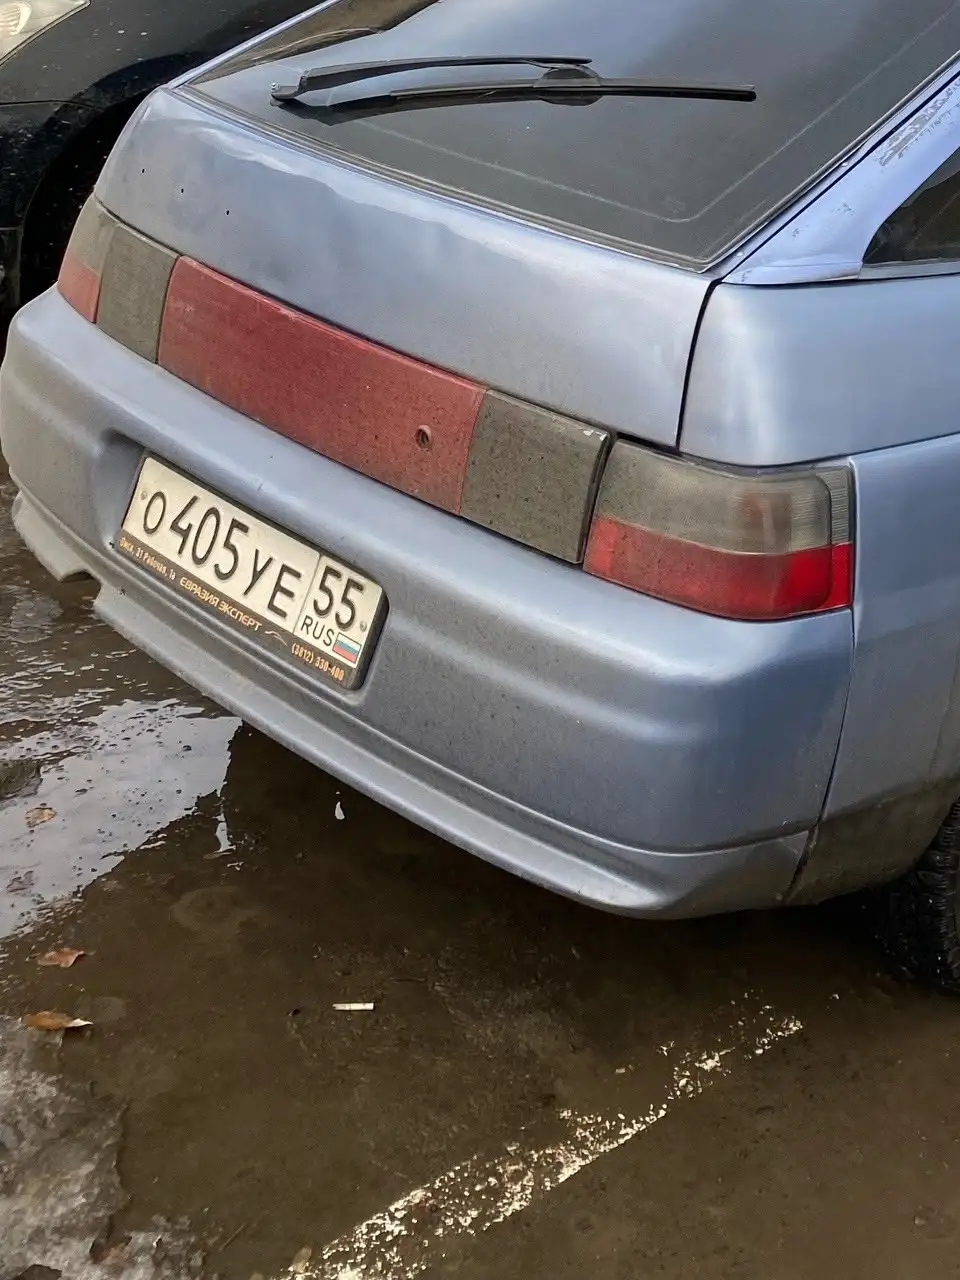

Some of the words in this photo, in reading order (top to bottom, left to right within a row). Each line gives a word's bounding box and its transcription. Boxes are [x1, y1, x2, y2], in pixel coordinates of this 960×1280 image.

[180, 576, 220, 607] ЕВРАЗИЯ
[218, 601, 262, 631] ЭКСПЕРТ
[313, 565, 364, 630] 55
[300, 614, 335, 647] RUS
